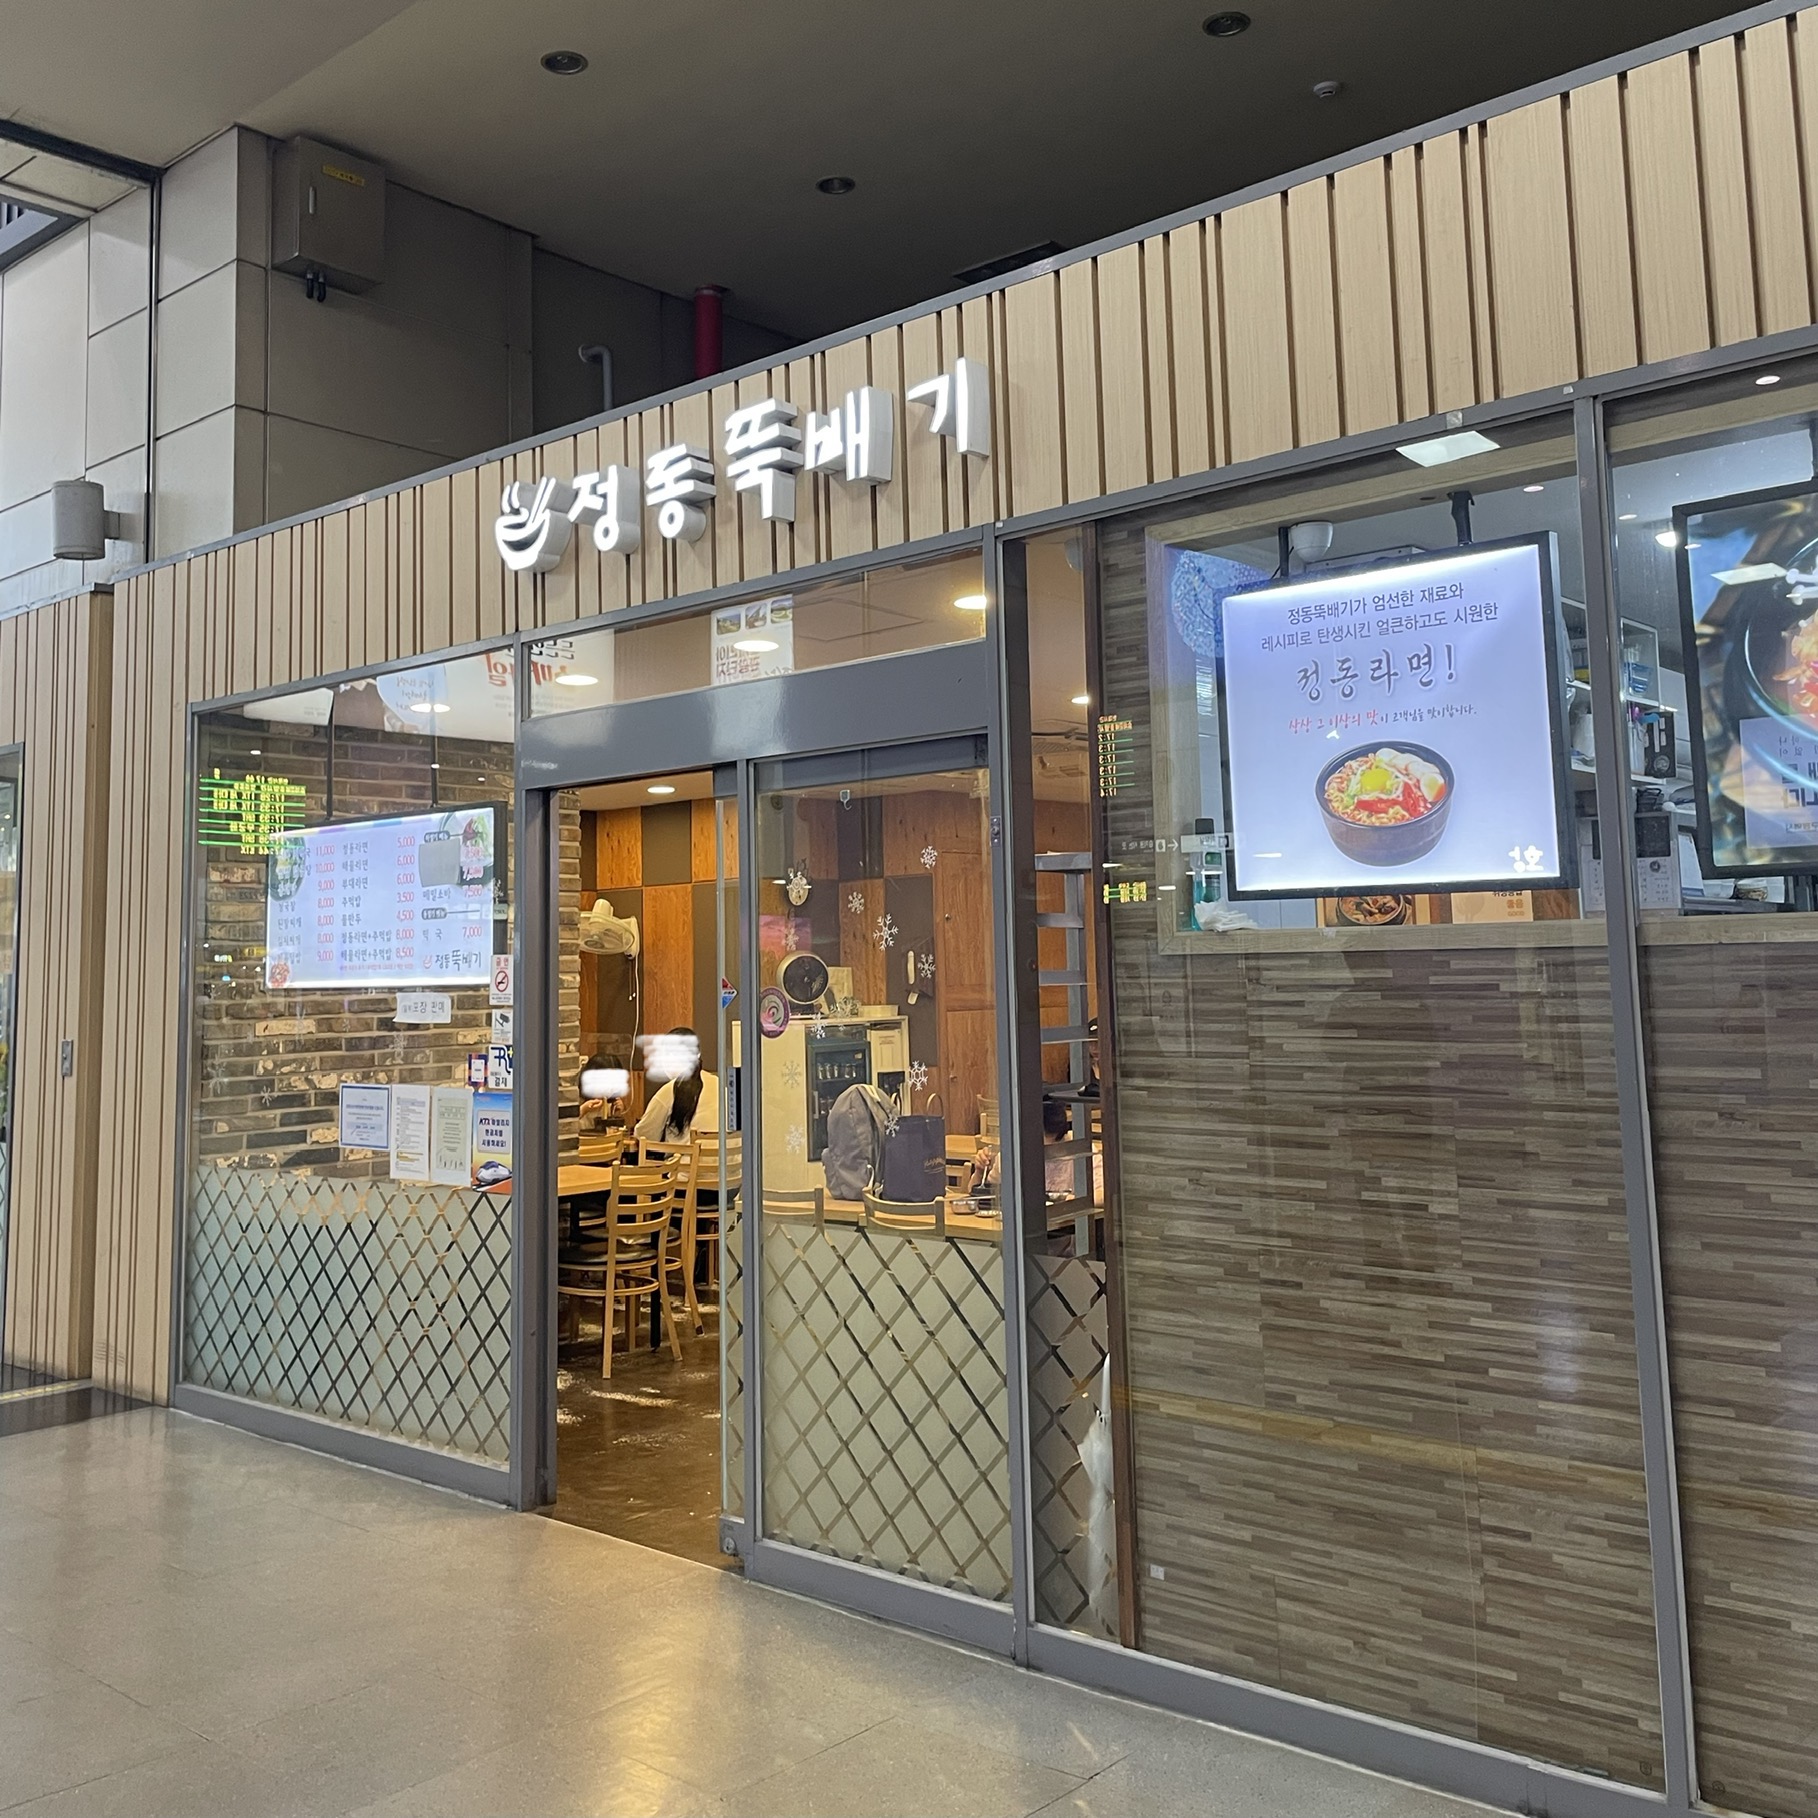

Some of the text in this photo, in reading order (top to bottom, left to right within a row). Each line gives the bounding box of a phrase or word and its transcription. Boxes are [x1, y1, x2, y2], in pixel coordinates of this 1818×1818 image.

[567, 357, 972, 552] 정동뚝배기
[1288, 582, 1464, 625] 정동뚝배기가 엄선한 재료와
[1261, 602, 1499, 652] 레시피로 탄생시킨 얼큰하고도 시원한
[1297, 643, 1456, 701] 정동라면!
[1289, 717, 1311, 734] 상상
[1316, 718, 1325, 728] 그
[1329, 713, 1361, 728] 이상의
[397, 836, 415, 848] 5,000
[397, 854, 415, 866] 6,000
[318, 880, 334, 891] 9,000
[397, 872, 415, 885] 6,000
[317, 897, 334, 908] 8,000
[317, 915, 334, 927] 8,000
[395, 928, 414, 941] 8,000
[462, 925, 482, 938] 7,000
[435, 949, 482, 971] 정동뚝배기
